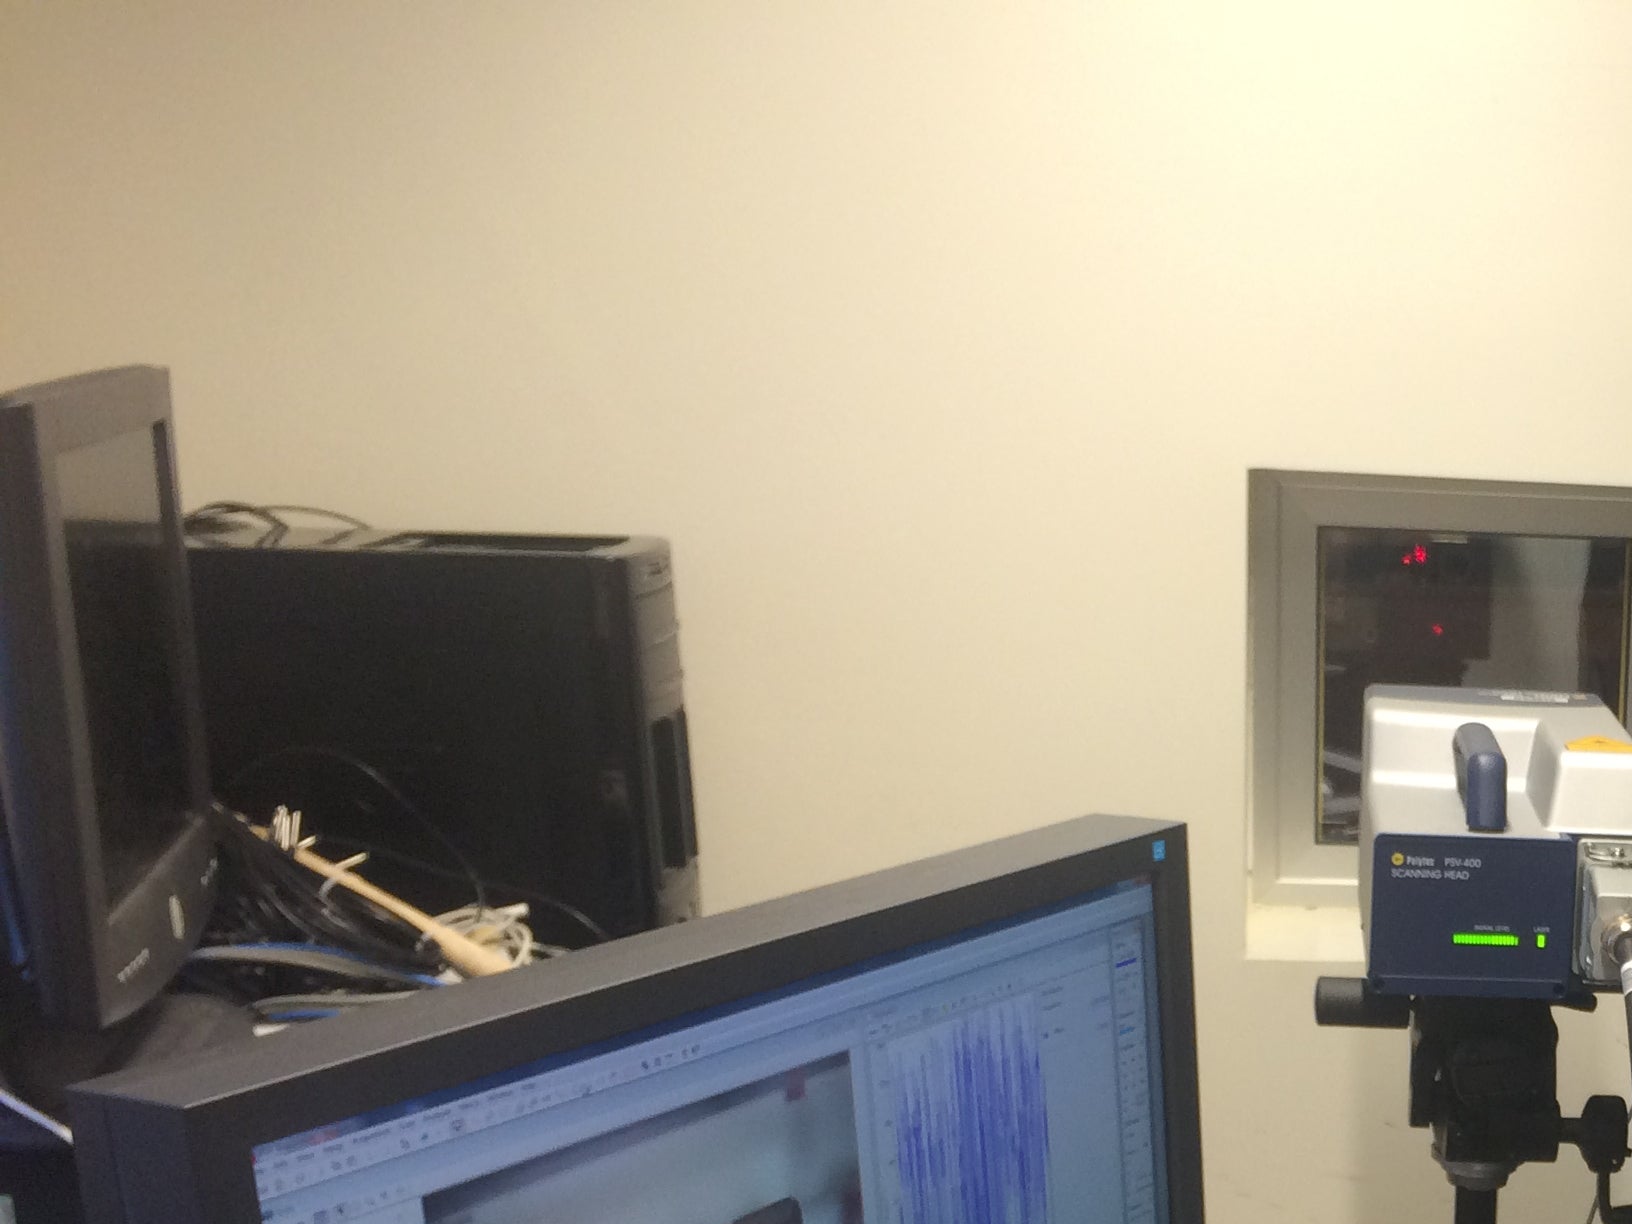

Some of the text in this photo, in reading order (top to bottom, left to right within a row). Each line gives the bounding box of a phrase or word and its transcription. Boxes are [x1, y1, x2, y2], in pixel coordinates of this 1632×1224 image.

[1444, 857, 1482, 868] PSV-400
[1391, 868, 1470, 880] SCANNING HEAD
